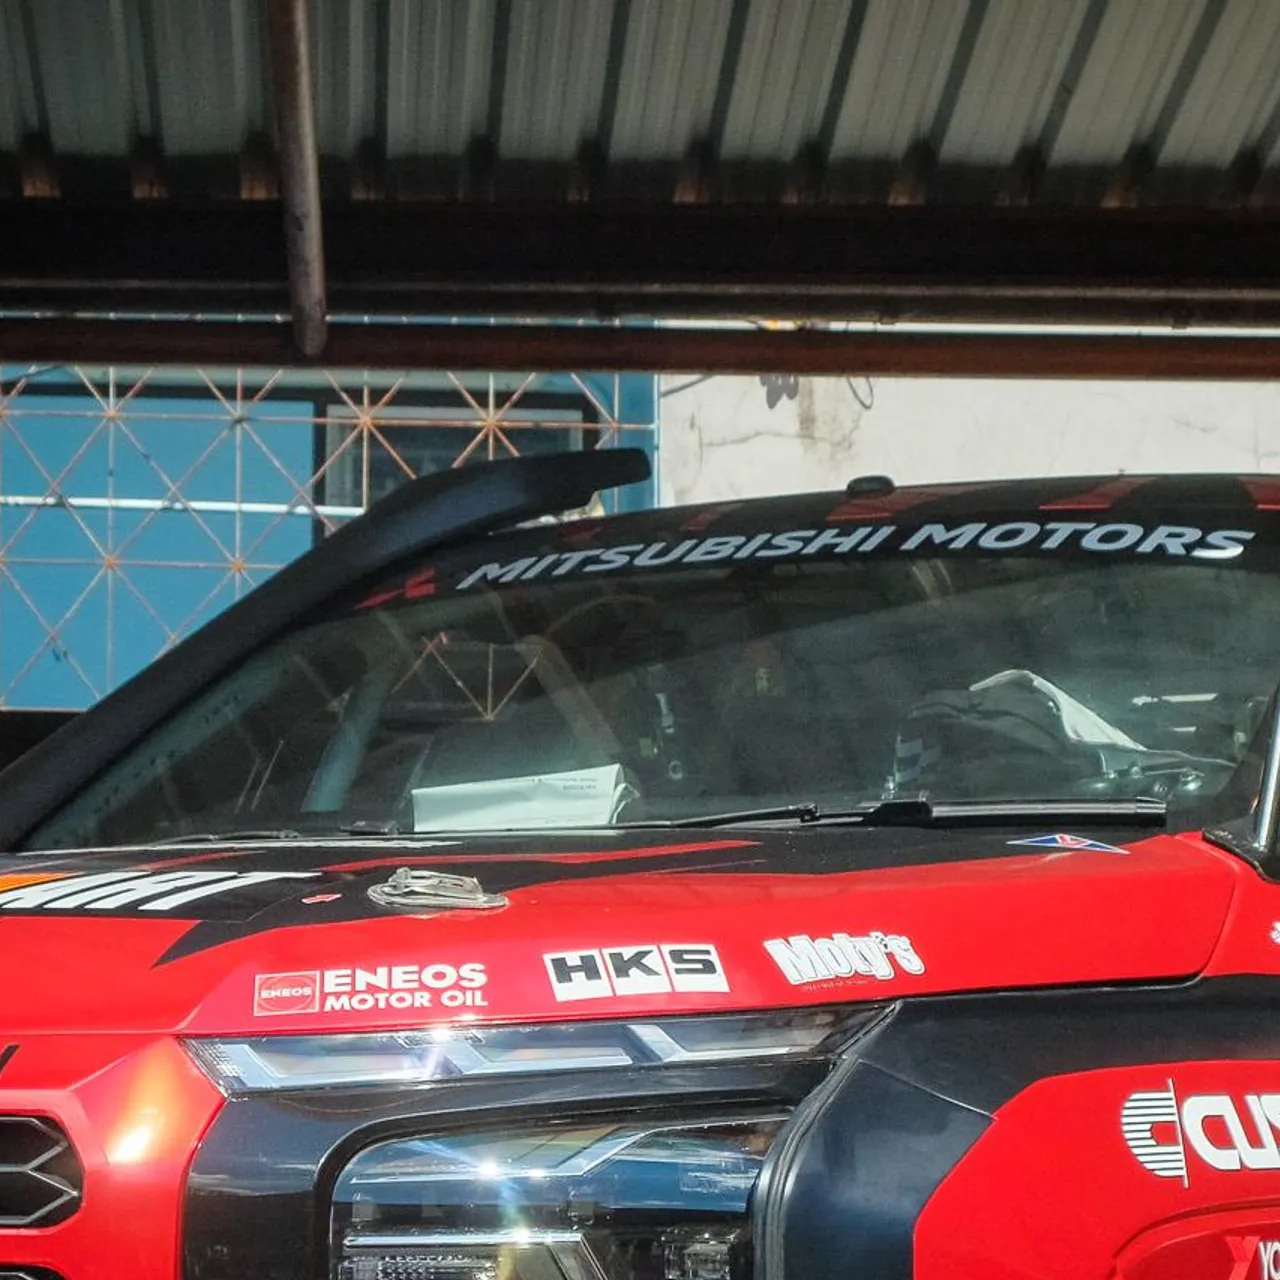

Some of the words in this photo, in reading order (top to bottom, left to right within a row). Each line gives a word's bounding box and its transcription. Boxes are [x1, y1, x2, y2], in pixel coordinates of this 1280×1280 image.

[456, 522, 897, 591] MITSUBISHI
[900, 520, 1256, 561] MOTORS
[552, 946, 718, 983] HKS
[764, 931, 926, 985] Moty's
[261, 986, 313, 999] ENEOS
[324, 963, 488, 993] ENEOS
[324, 991, 432, 1012] MOTOR
[440, 989, 489, 1007] OIL
